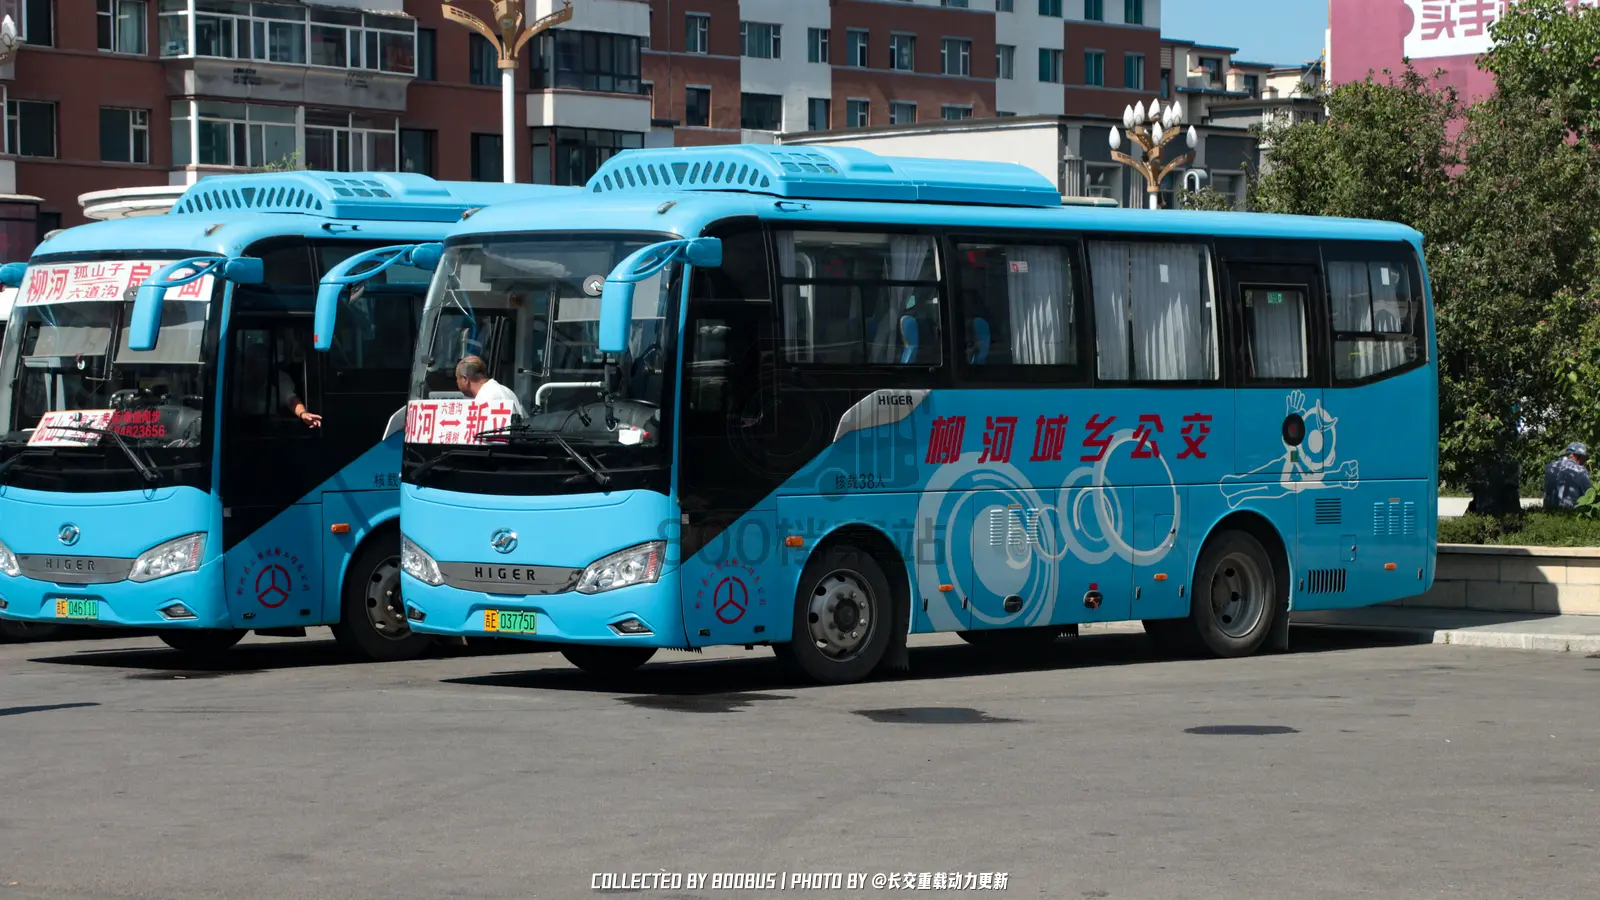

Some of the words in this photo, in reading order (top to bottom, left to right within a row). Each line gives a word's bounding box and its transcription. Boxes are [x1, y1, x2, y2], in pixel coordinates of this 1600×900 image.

[73, 262, 125, 280] 孤山子
[26, 268, 70, 303] 柳河
[68, 284, 119, 300] 六道沟
[878, 395, 913, 406] HIGER
[441, 402, 463, 416] 六道沟
[405, 402, 438, 444] 柳河
[924, 412, 1213, 464] 柳河城乡公交
[835, 473, 886, 490] 核载38人
[45, 557, 96, 571] HIGER
[475, 566, 536, 581] HIGER
